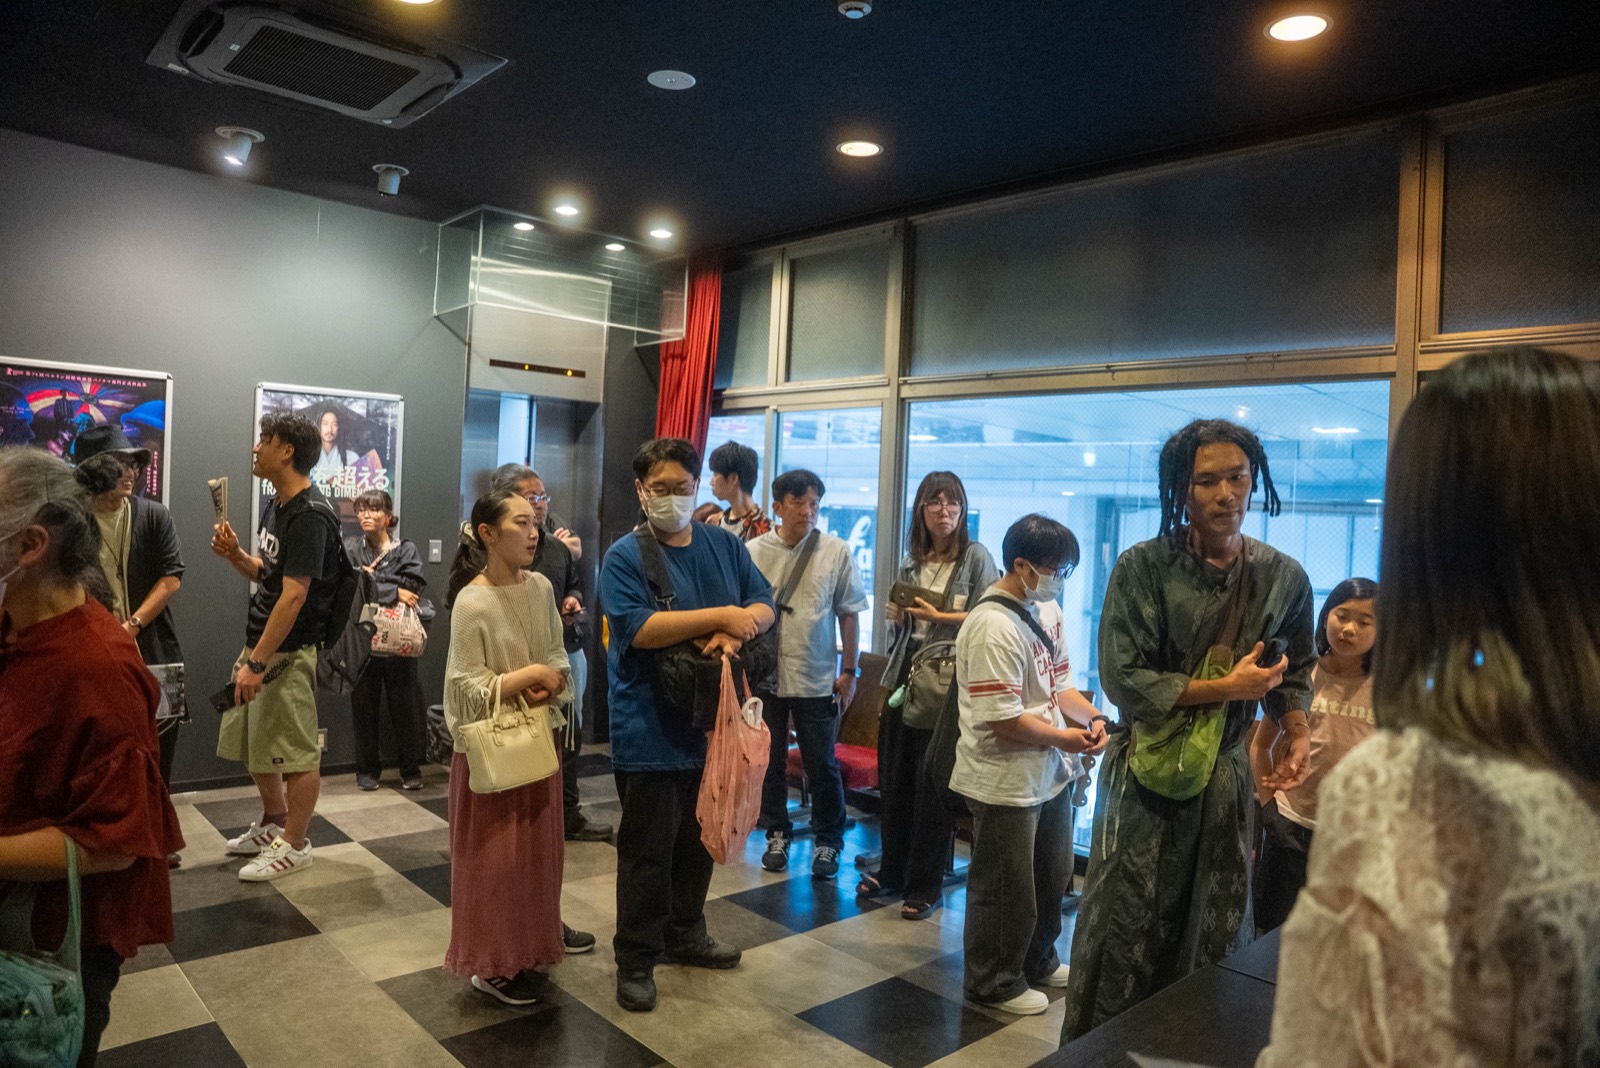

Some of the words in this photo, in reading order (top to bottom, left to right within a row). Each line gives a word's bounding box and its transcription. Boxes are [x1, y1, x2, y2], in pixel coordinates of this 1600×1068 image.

[314, 466, 389, 489] を超える
[1310, 697, 1375, 724] elting
